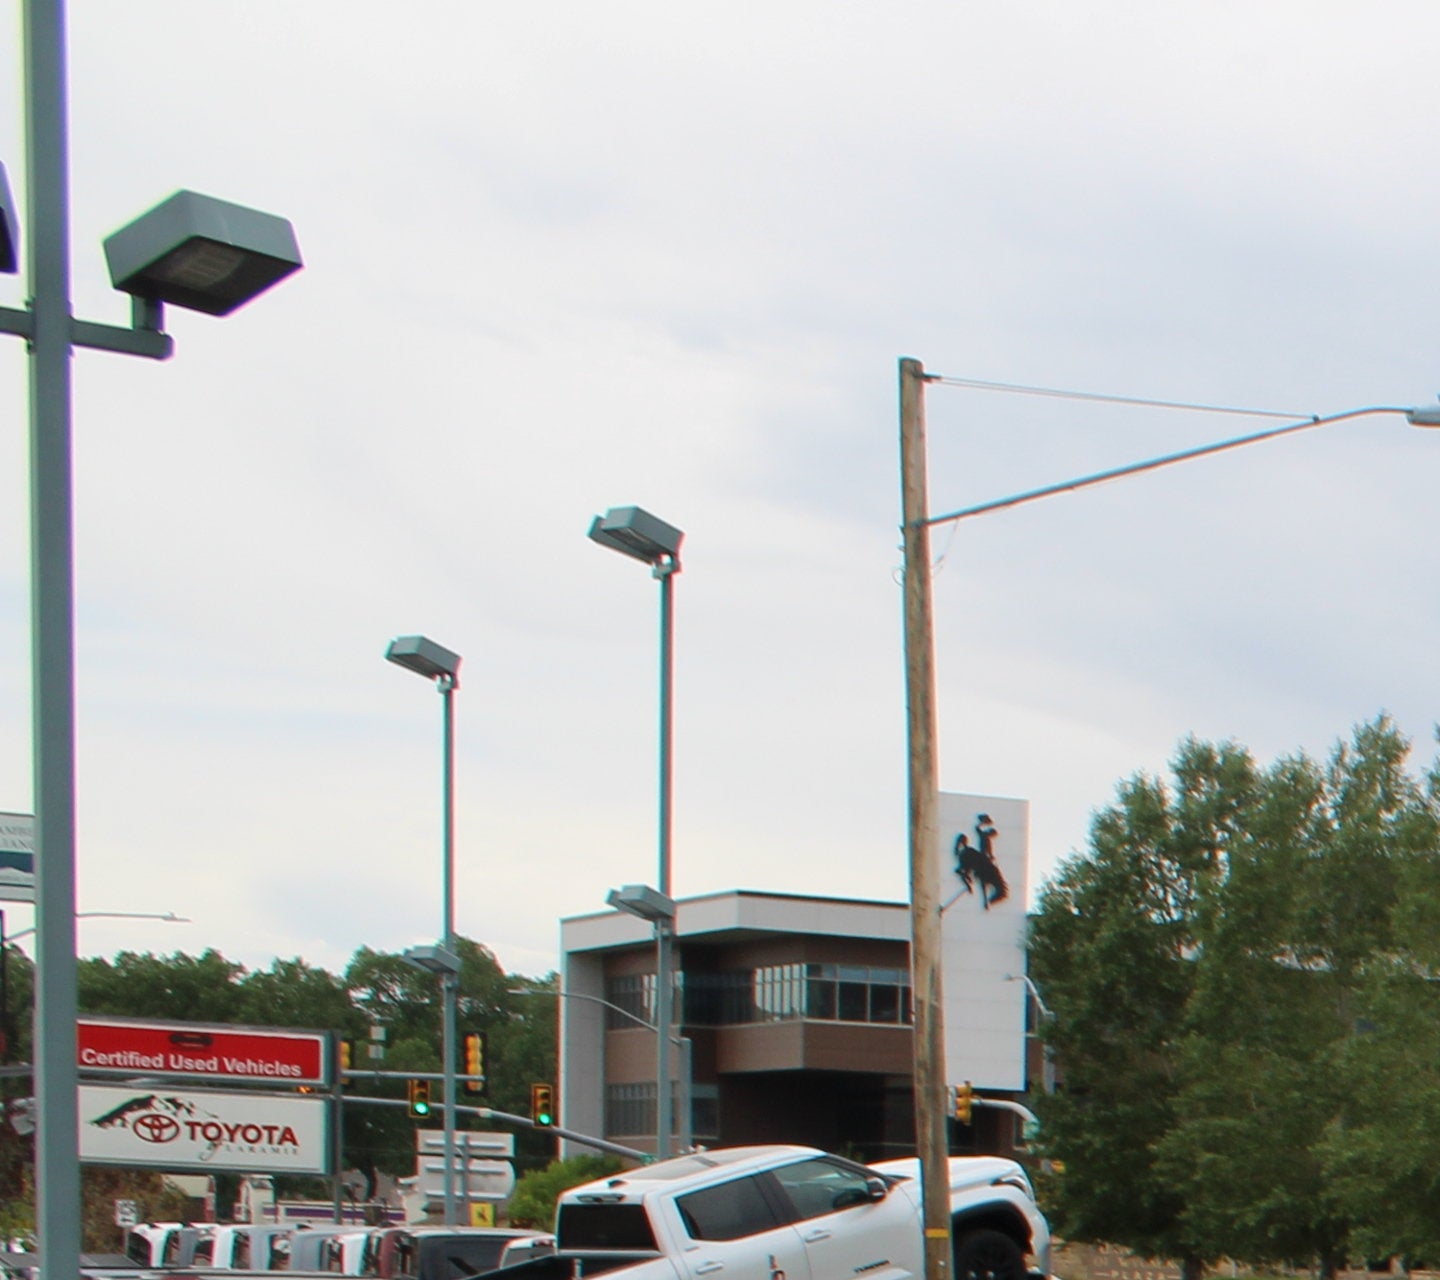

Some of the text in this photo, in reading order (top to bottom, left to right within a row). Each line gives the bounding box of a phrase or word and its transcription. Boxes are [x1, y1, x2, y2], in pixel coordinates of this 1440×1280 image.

[81, 1048, 302, 1077] Certified Used Vehicles
[185, 1121, 299, 1146] TOYOTA
[1110, 1269, 1166, 1280] PLAZA
